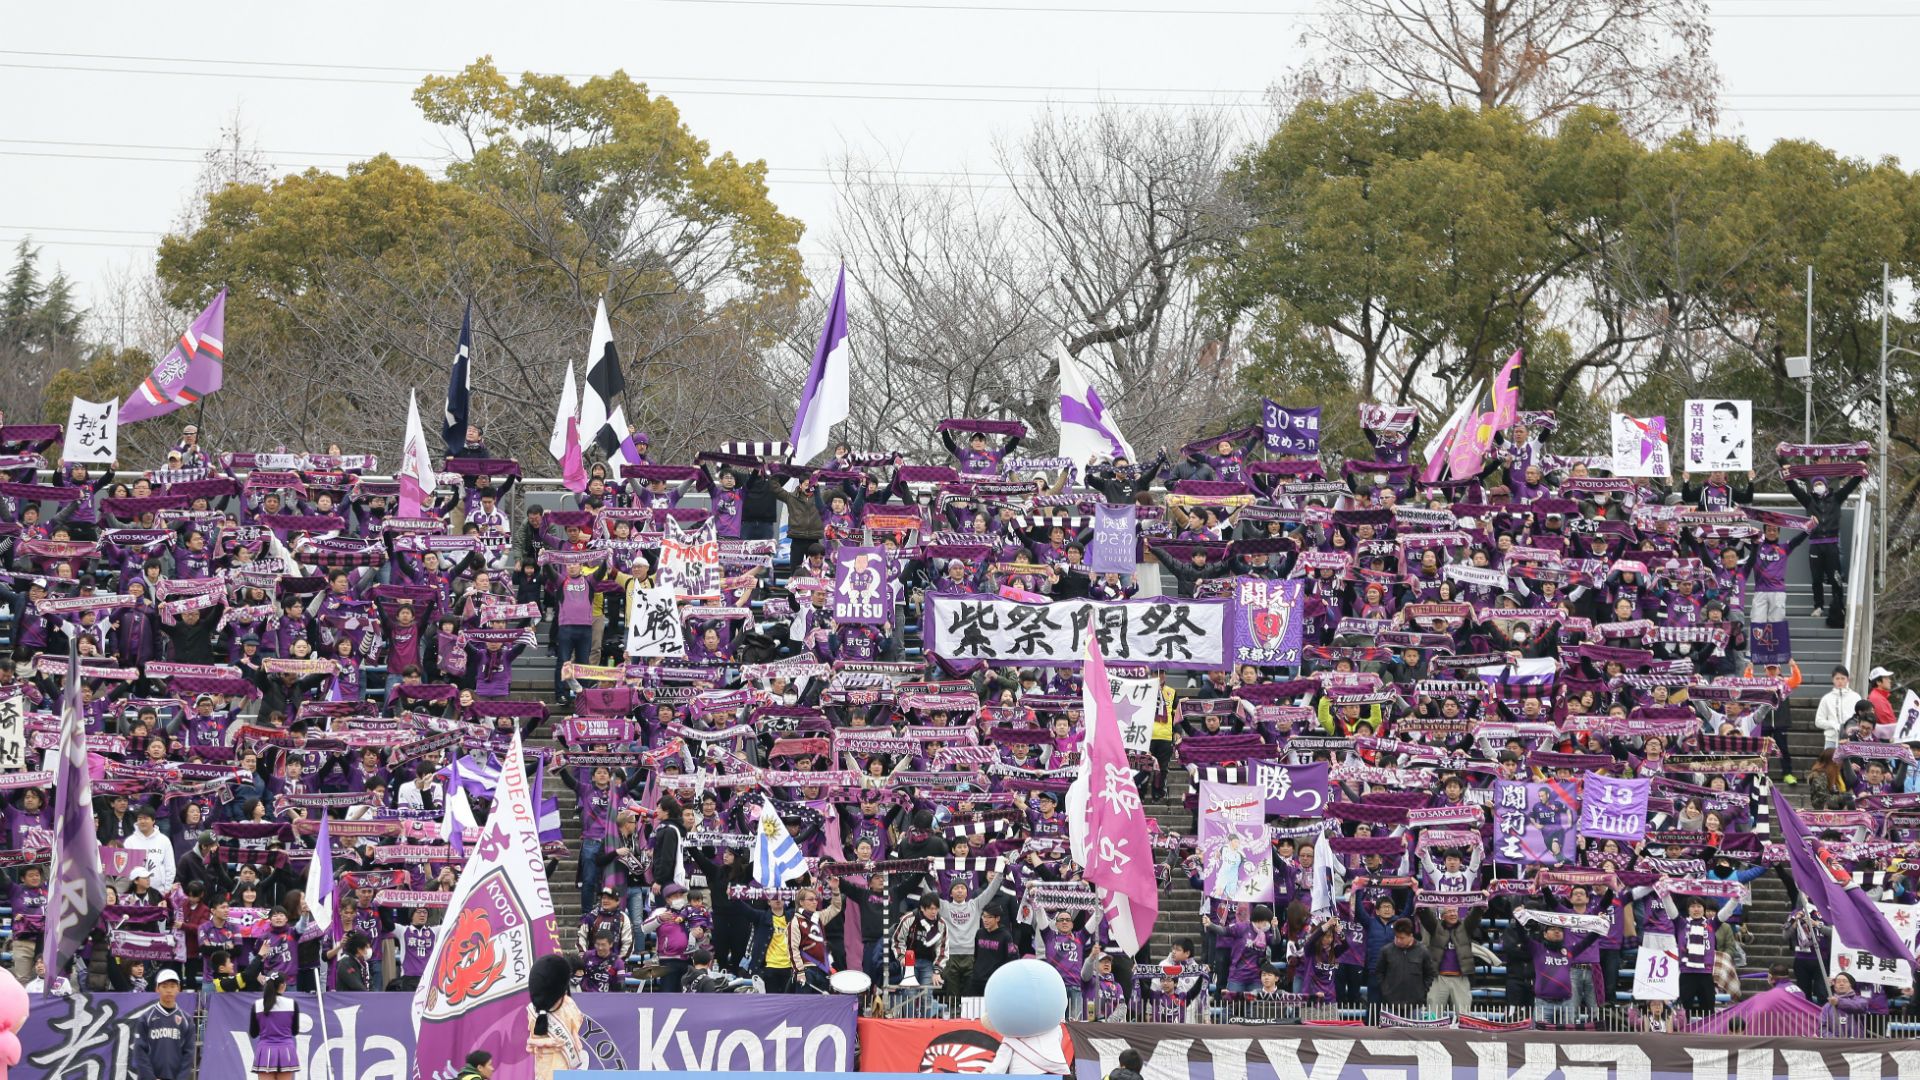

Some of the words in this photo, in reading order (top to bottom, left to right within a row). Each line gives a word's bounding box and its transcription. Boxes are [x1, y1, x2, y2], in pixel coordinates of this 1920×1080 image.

[1267, 405, 1289, 430] 30
[74, 413, 97, 447] 挑む
[969, 460, 990, 468] 京セラ
[1222, 466, 1241, 475] 京セラ
[1575, 481, 1603, 489] KYOTO
[1605, 481, 1629, 489] SANG
[728, 506, 736, 514] 15
[1103, 517, 1129, 530] 快速
[1706, 515, 1732, 523] SANGA
[108, 534, 131, 542] KYOTO
[236, 526, 261, 541] 京都
[1012, 536, 1021, 546] 10
[1369, 543, 1394, 555] 京都
[685, 562, 702, 578] IS
[567, 584, 586, 592] 京セラ
[57, 600, 80, 609] KYOTO
[81, 599, 104, 607] SANGA
[1329, 597, 1339, 607] 12
[836, 604, 884, 618] BITSU
[1492, 608, 1516, 616] KYOTO
[1518, 608, 1542, 616] SANGA
[1687, 612, 1695, 622] 13
[1306, 624, 1315, 634] 13
[847, 638, 870, 647] 京セラ
[860, 647, 870, 657] 30
[1237, 646, 1297, 662] 京都サンガ
[146, 664, 173, 673] KYOTO
[174, 666, 203, 674] SANGA
[844, 664, 870, 672] KYOTO
[657, 688, 698, 698] VAMOS
[367, 721, 379, 730] OF
[588, 721, 609, 729] KYOTO
[588, 728, 609, 736] SANGA
[1123, 722, 1147, 744] 都
[211, 739, 220, 748] 13
[850, 740, 878, 749] KYOTO
[880, 741, 910, 750] SANGA
[1440, 756, 1467, 770] 京都
[196, 768, 221, 778] SANGA
[503, 738, 527, 802] PRIDE
[15, 774, 38, 783] SANGA
[1256, 764, 1321, 812] 勝つ
[1601, 785, 1633, 805] 13
[511, 803, 529, 826] of
[1427, 810, 1457, 818] SANGA
[873, 837, 880, 847] 15
[1678, 834, 1697, 842] SANGA
[389, 847, 421, 857] KYOTO
[422, 847, 456, 857] SANGA
[1896, 862, 1920, 871] YOTO
[386, 891, 418, 901] KYOTO
[732, 886, 763, 900] 京都
[486, 880, 516, 927] KYOTO
[1417, 894, 1445, 903] KYOTO
[1446, 894, 1459, 903] OF
[1461, 894, 1483, 903] PRIDE
[1340, 920, 1363, 930] 京セラ
[1353, 932, 1363, 943] 22
[408, 939, 431, 948] 京セラ
[1054, 942, 1077, 951] 京セラ
[282, 952, 292, 962] 13
[417, 947, 426, 957] 10
[510, 930, 527, 984] SANGA
[1068, 951, 1078, 962] 22
[1544, 955, 1569, 966] 京セラ
[1648, 955, 1669, 979] 13
[1260, 993, 1303, 1001] VAMOS
[637, 1007, 848, 1072] Kyoto
